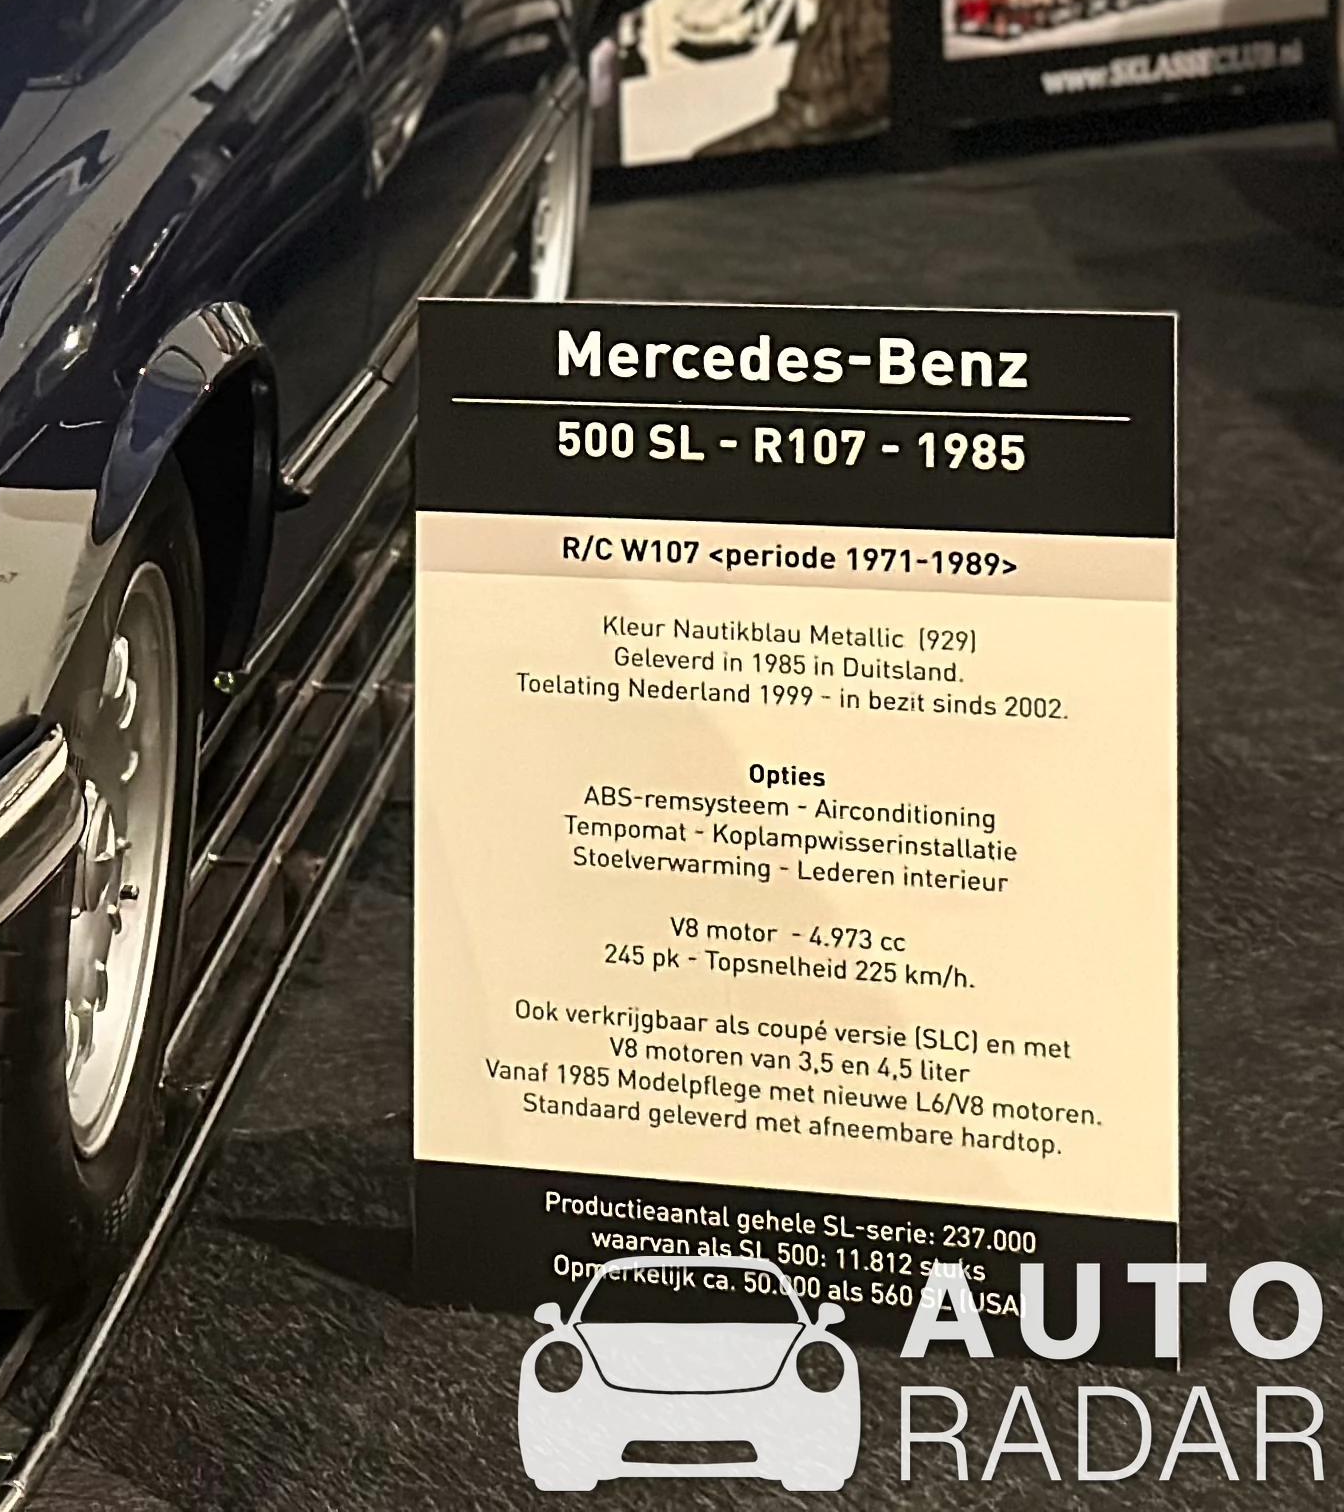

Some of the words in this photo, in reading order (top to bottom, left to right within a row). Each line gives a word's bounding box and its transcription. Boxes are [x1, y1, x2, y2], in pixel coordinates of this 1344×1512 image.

[558, 329, 1028, 389] Mercedes-Benz
[558, 421, 634, 459] 500
[649, 423, 705, 461] SL
[754, 427, 866, 466] R107
[918, 432, 1025, 471] 1985
[563, 535, 613, 562] R/C
[620, 538, 700, 564] W107
[709, 544, 836, 571] <periode
[846, 547, 1017, 576] 1971-1989>
[603, 615, 666, 638] Kleur
[673, 618, 801, 644] Nautikblau
[810, 624, 904, 649] Metallic
[919, 627, 976, 654] (929)
[614, 646, 714, 671] Geleverd
[723, 652, 743, 673] in
[752, 652, 806, 675] 1985
[814, 655, 834, 677] in
[843, 657, 964, 683] Duitsland.
[516, 672, 620, 702] Toelating
[629, 677, 750, 704] Nederland
[760, 684, 813, 706] 1999
[840, 687, 860, 709] in
[869, 689, 925, 713] bezit
[933, 693, 997, 716] sinds
[1004, 695, 1068, 720] 2002.
[749, 763, 826, 789] Opties
[583, 785, 789, 818] ABS-remsysteem
[814, 798, 995, 834] Airconditioning
[563, 814, 687, 843] Tempomat
[713, 823, 1018, 862] Koplampwisserinstallatie
[573, 845, 771, 884] Stoelverwarming
[798, 859, 895, 886] Lederen
[903, 865, 1009, 893] interieur
[669, 916, 699, 938] V8
[706, 922, 778, 943] motor
[809, 925, 872, 950] 4.973
[880, 936, 906, 952] cc
[604, 943, 645, 966] 245
[653, 947, 680, 973] pk
[704, 949, 847, 980] Topsnelheid
[855, 959, 897, 983] 225
[905, 963, 975, 989] km/h.
[515, 998, 559, 1022] Ook
[565, 1004, 709, 1035] verkrijgbaar
[715, 1014, 750, 1036] als
[757, 1019, 828, 1045] coupé
[834, 1025, 907, 1047] versie
[915, 1025, 978, 1054] (SLC)
[986, 1038, 1015, 1055] en
[1024, 1040, 1071, 1059] met
[609, 1036, 638, 1059] V8
[645, 1044, 743, 1067] motoren
[750, 1052, 791, 1070] van
[798, 1050, 834, 1075] 3,5
[841, 1059, 870, 1076] en
[877, 1056, 913, 1081] 4,5
[920, 1059, 971, 1083] liter
[485, 1058, 549, 1082] Vanaf
[557, 1064, 610, 1088] 1985
[618, 1068, 761, 1104] Modelpflege
[769, 1084, 815, 1104] met
[823, 1084, 908, 1111] nieuwe
[916, 1091, 984, 1117] L6/V8
[992, 1101, 1102, 1126] motoren.
[523, 1092, 640, 1121] Standaard
[648, 1104, 747, 1130] geleverd
[755, 1115, 802, 1135] met
[808, 1115, 954, 1146] afneembare
[961, 1126, 1062, 1159] hardtop.
[545, 1191, 730, 1227] Productieaantal
[737, 1205, 816, 1235] gehele
[823, 1214, 935, 1245] SL-serie:
[942, 1224, 1036, 1254] 237.000
[592, 1232, 689, 1255] waarvan
[698, 1238, 731, 1258] als
[740, 1240, 769, 1261] SL
[778, 1243, 826, 1267] 500:
[836, 1248, 912, 1275] 11.812
[920, 1257, 986, 1282] stuks
[554, 1254, 695, 1291] Opmerkelijk
[703, 1272, 735, 1291] ca.
[744, 1271, 821, 1299] 50.000
[828, 1281, 863, 1303] als
[871, 1284, 912, 1307] 560
[920, 1288, 952, 1312] SL
